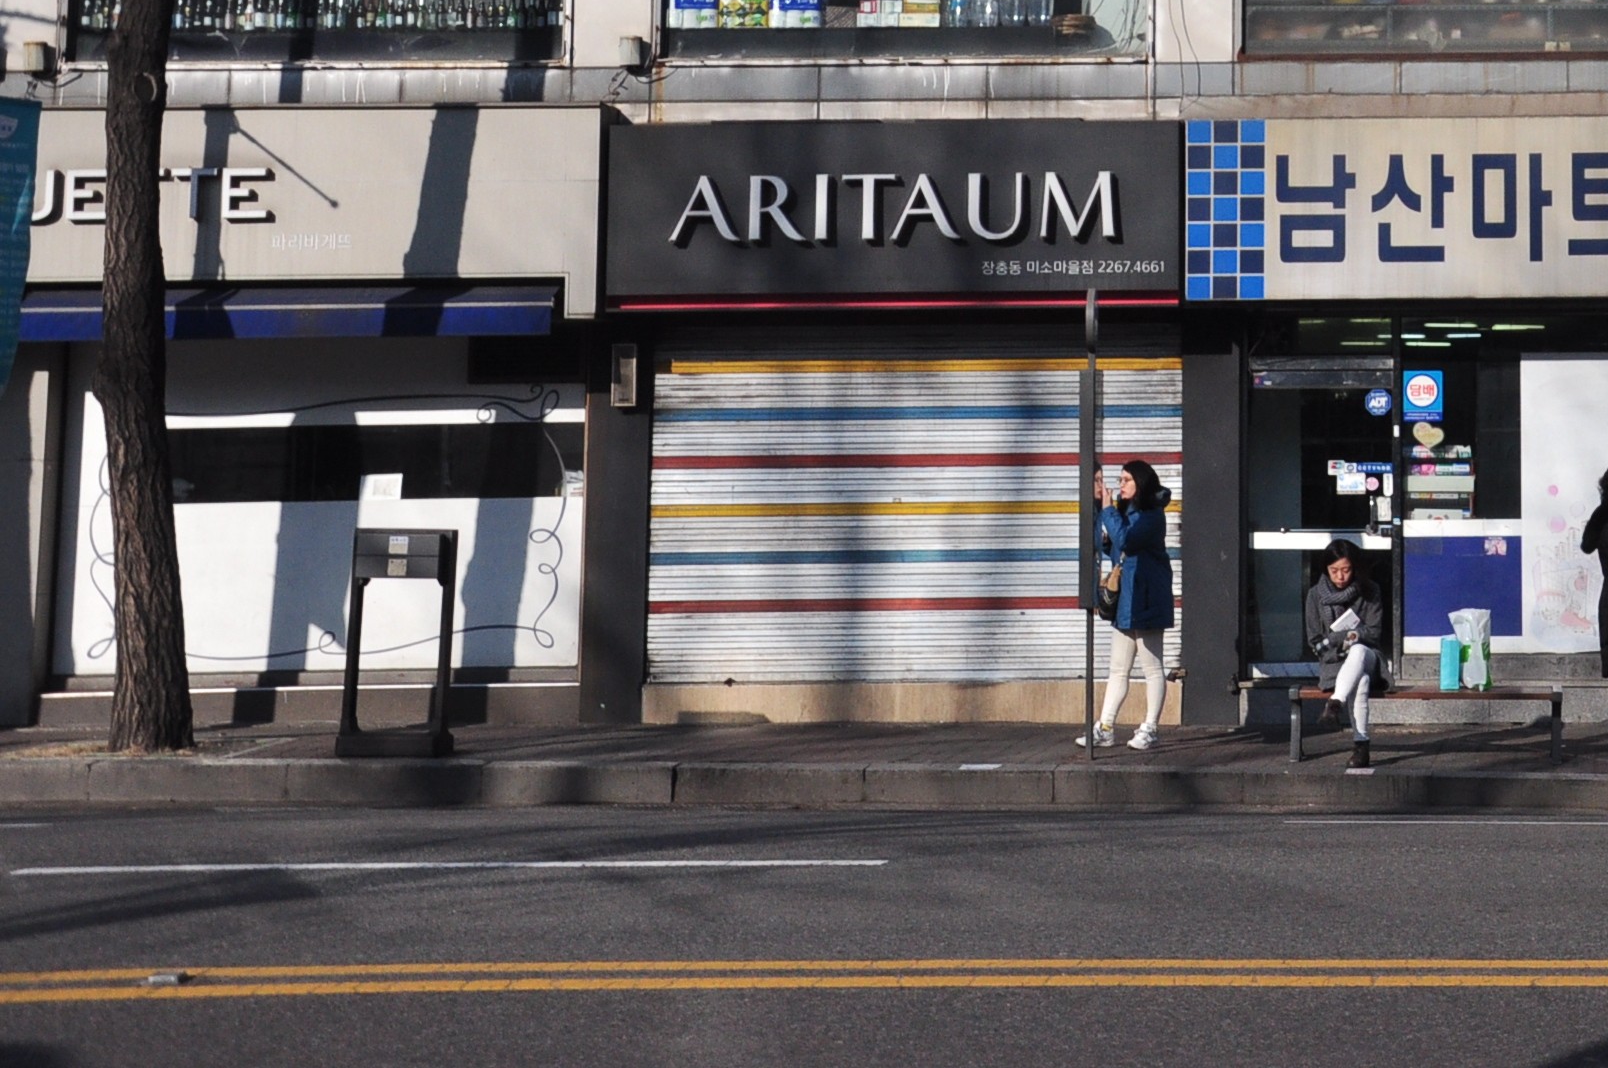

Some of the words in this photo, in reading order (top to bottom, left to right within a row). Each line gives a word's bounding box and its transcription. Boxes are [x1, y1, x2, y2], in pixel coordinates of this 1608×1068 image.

[668, 171, 1117, 242] ARITAUM
[271, 233, 352, 250] 파리바게뜨
[1026, 259, 1094, 275] 미소마을점
[1409, 383, 1436, 397] 담배
[1368, 396, 1389, 409] ADT
